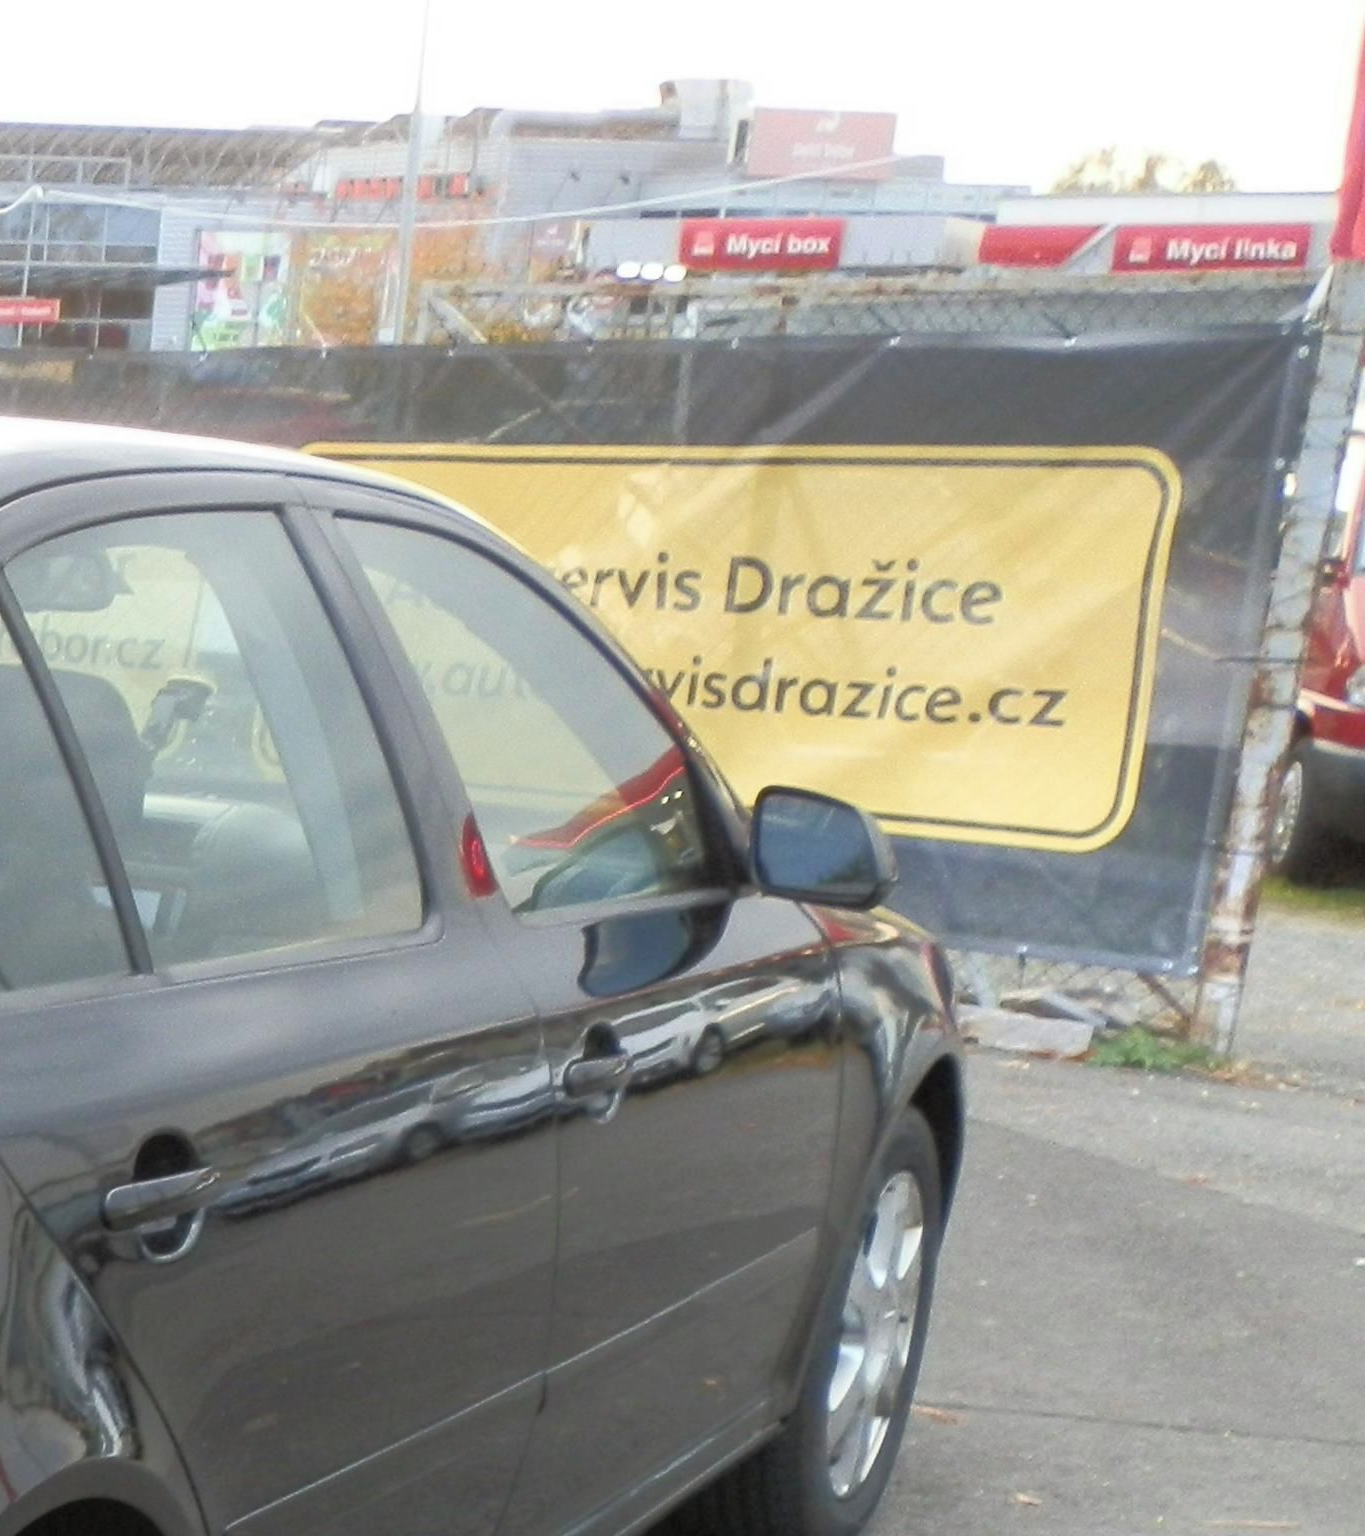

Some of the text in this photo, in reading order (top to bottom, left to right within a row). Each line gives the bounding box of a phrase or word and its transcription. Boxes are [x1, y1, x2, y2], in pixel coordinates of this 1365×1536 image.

[726, 231, 833, 260] Mycí box
[1165, 237, 1299, 266] Mycí linka
[557, 551, 1004, 625] ervis Dražice
